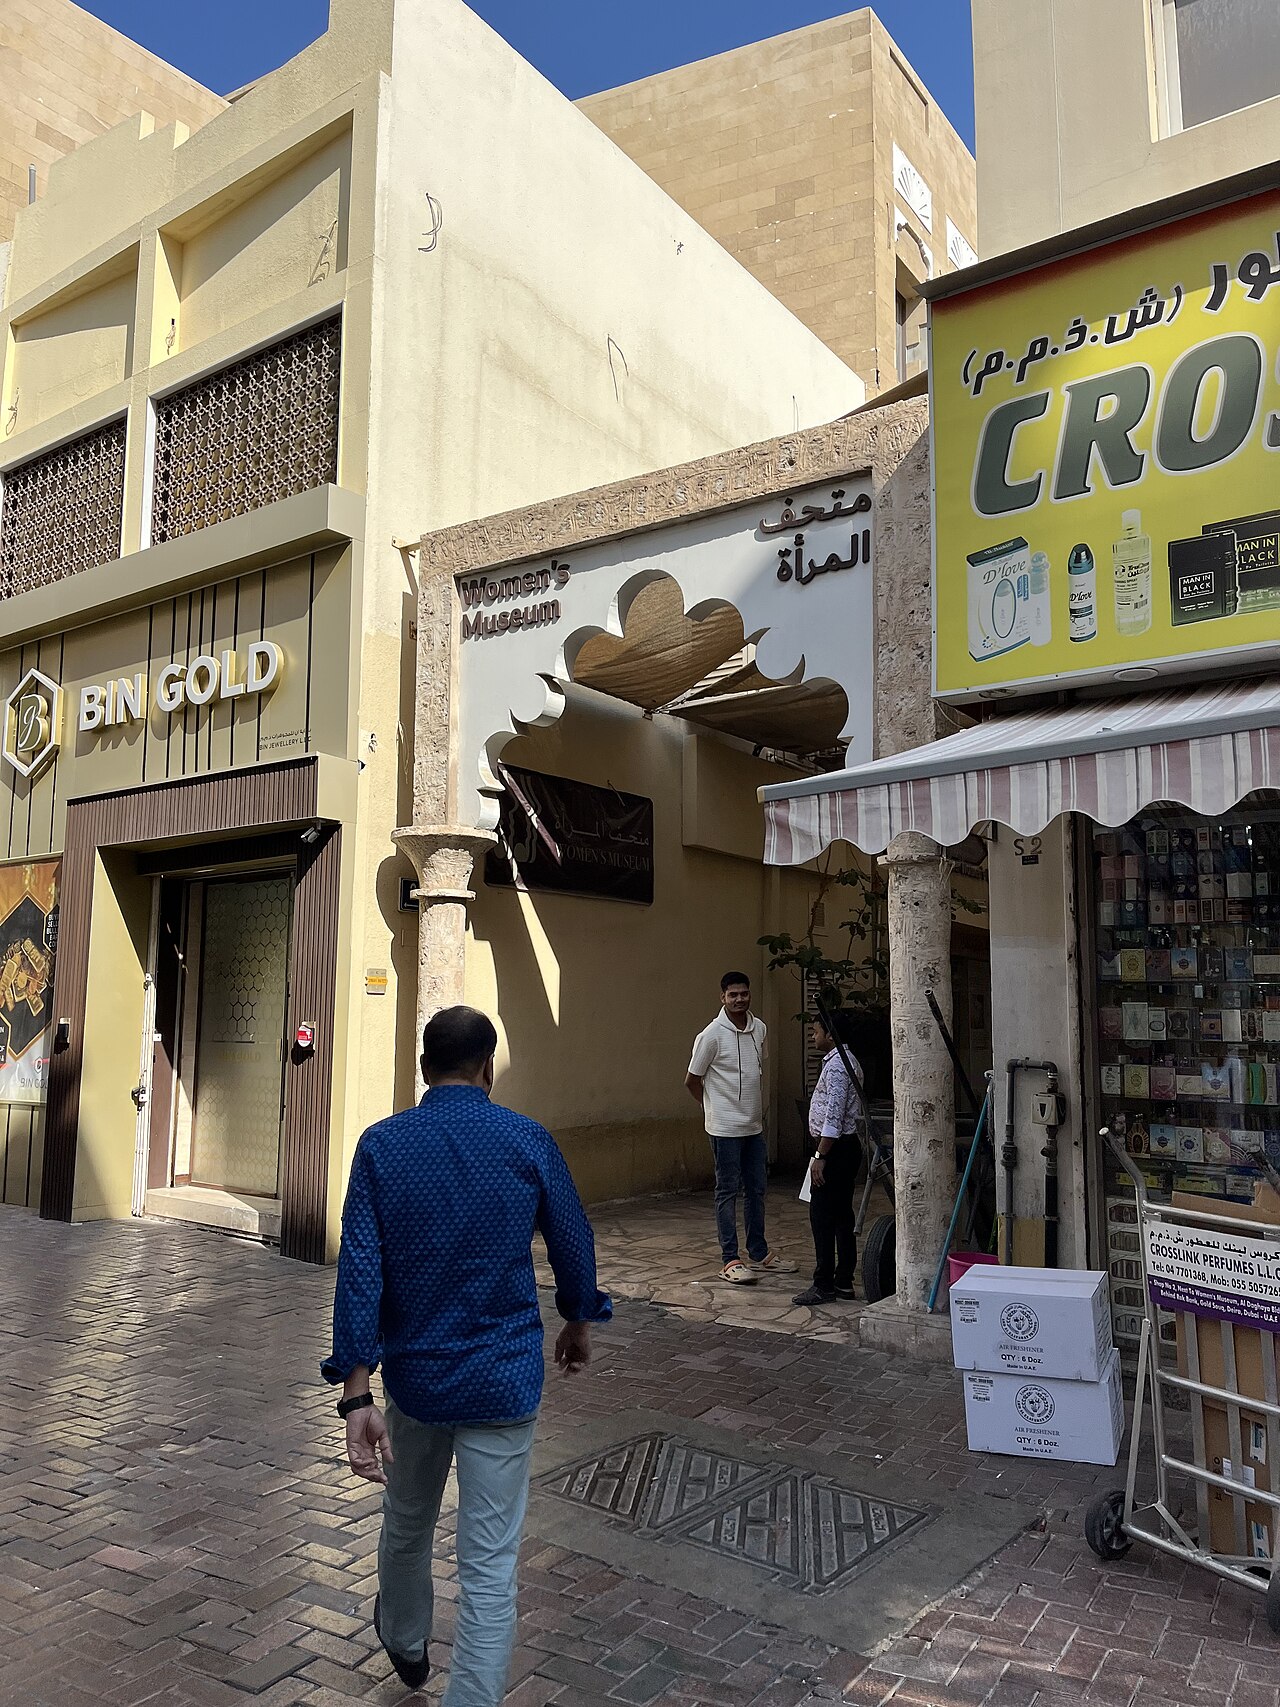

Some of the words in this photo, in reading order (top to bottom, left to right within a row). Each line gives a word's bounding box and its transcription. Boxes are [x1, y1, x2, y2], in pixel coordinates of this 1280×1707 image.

[1205, 232, 1280, 312] ور
[975, 335, 1280, 514] CRO
[759, 489, 872, 533] متحف
[1263, 538, 1275, 548] IN
[777, 529, 870, 585] المرأة
[1241, 550, 1275, 564] LACK
[461, 560, 571, 606] Women's
[1182, 576, 1201, 585] MAN
[1182, 582, 1211, 593] BLACK
[462, 599, 561, 638] Museum
[79, 673, 147, 732] BIN
[156, 640, 284, 712] GOLD
[269, 738, 298, 750] JEWELLERY
[1186, 1237, 1219, 1250] للعطور
[1150, 1243, 1201, 1266] CROSSLINK
[1202, 1253, 1254, 1276] PERFUMES
[1151, 1261, 1164, 1271] Tel:
[1166, 1264, 1175, 1274] 04
[1210, 1273, 1229, 1287] Mob:
[1231, 1279, 1246, 1290] 055
[1248, 1281, 1280, 1297] 505726
[1153, 1279, 1164, 1289] Shop
[1194, 1289, 1216, 1300] Women's
[1160, 1289, 1176, 1300] Behind
[1200, 1299, 1212, 1308] Gold
[1243, 1309, 1260, 1319] Dubai
[1001, 1353, 1016, 1361] QTY
[1028, 1356, 1043, 1364] Doz.
[1010, 1345, 1044, 1353] FRESHENER
[1016, 1436, 1031, 1445] QTY
[1043, 1439, 1059, 1447] Doz.
[1025, 1427, 1060, 1436] FRESHENER
